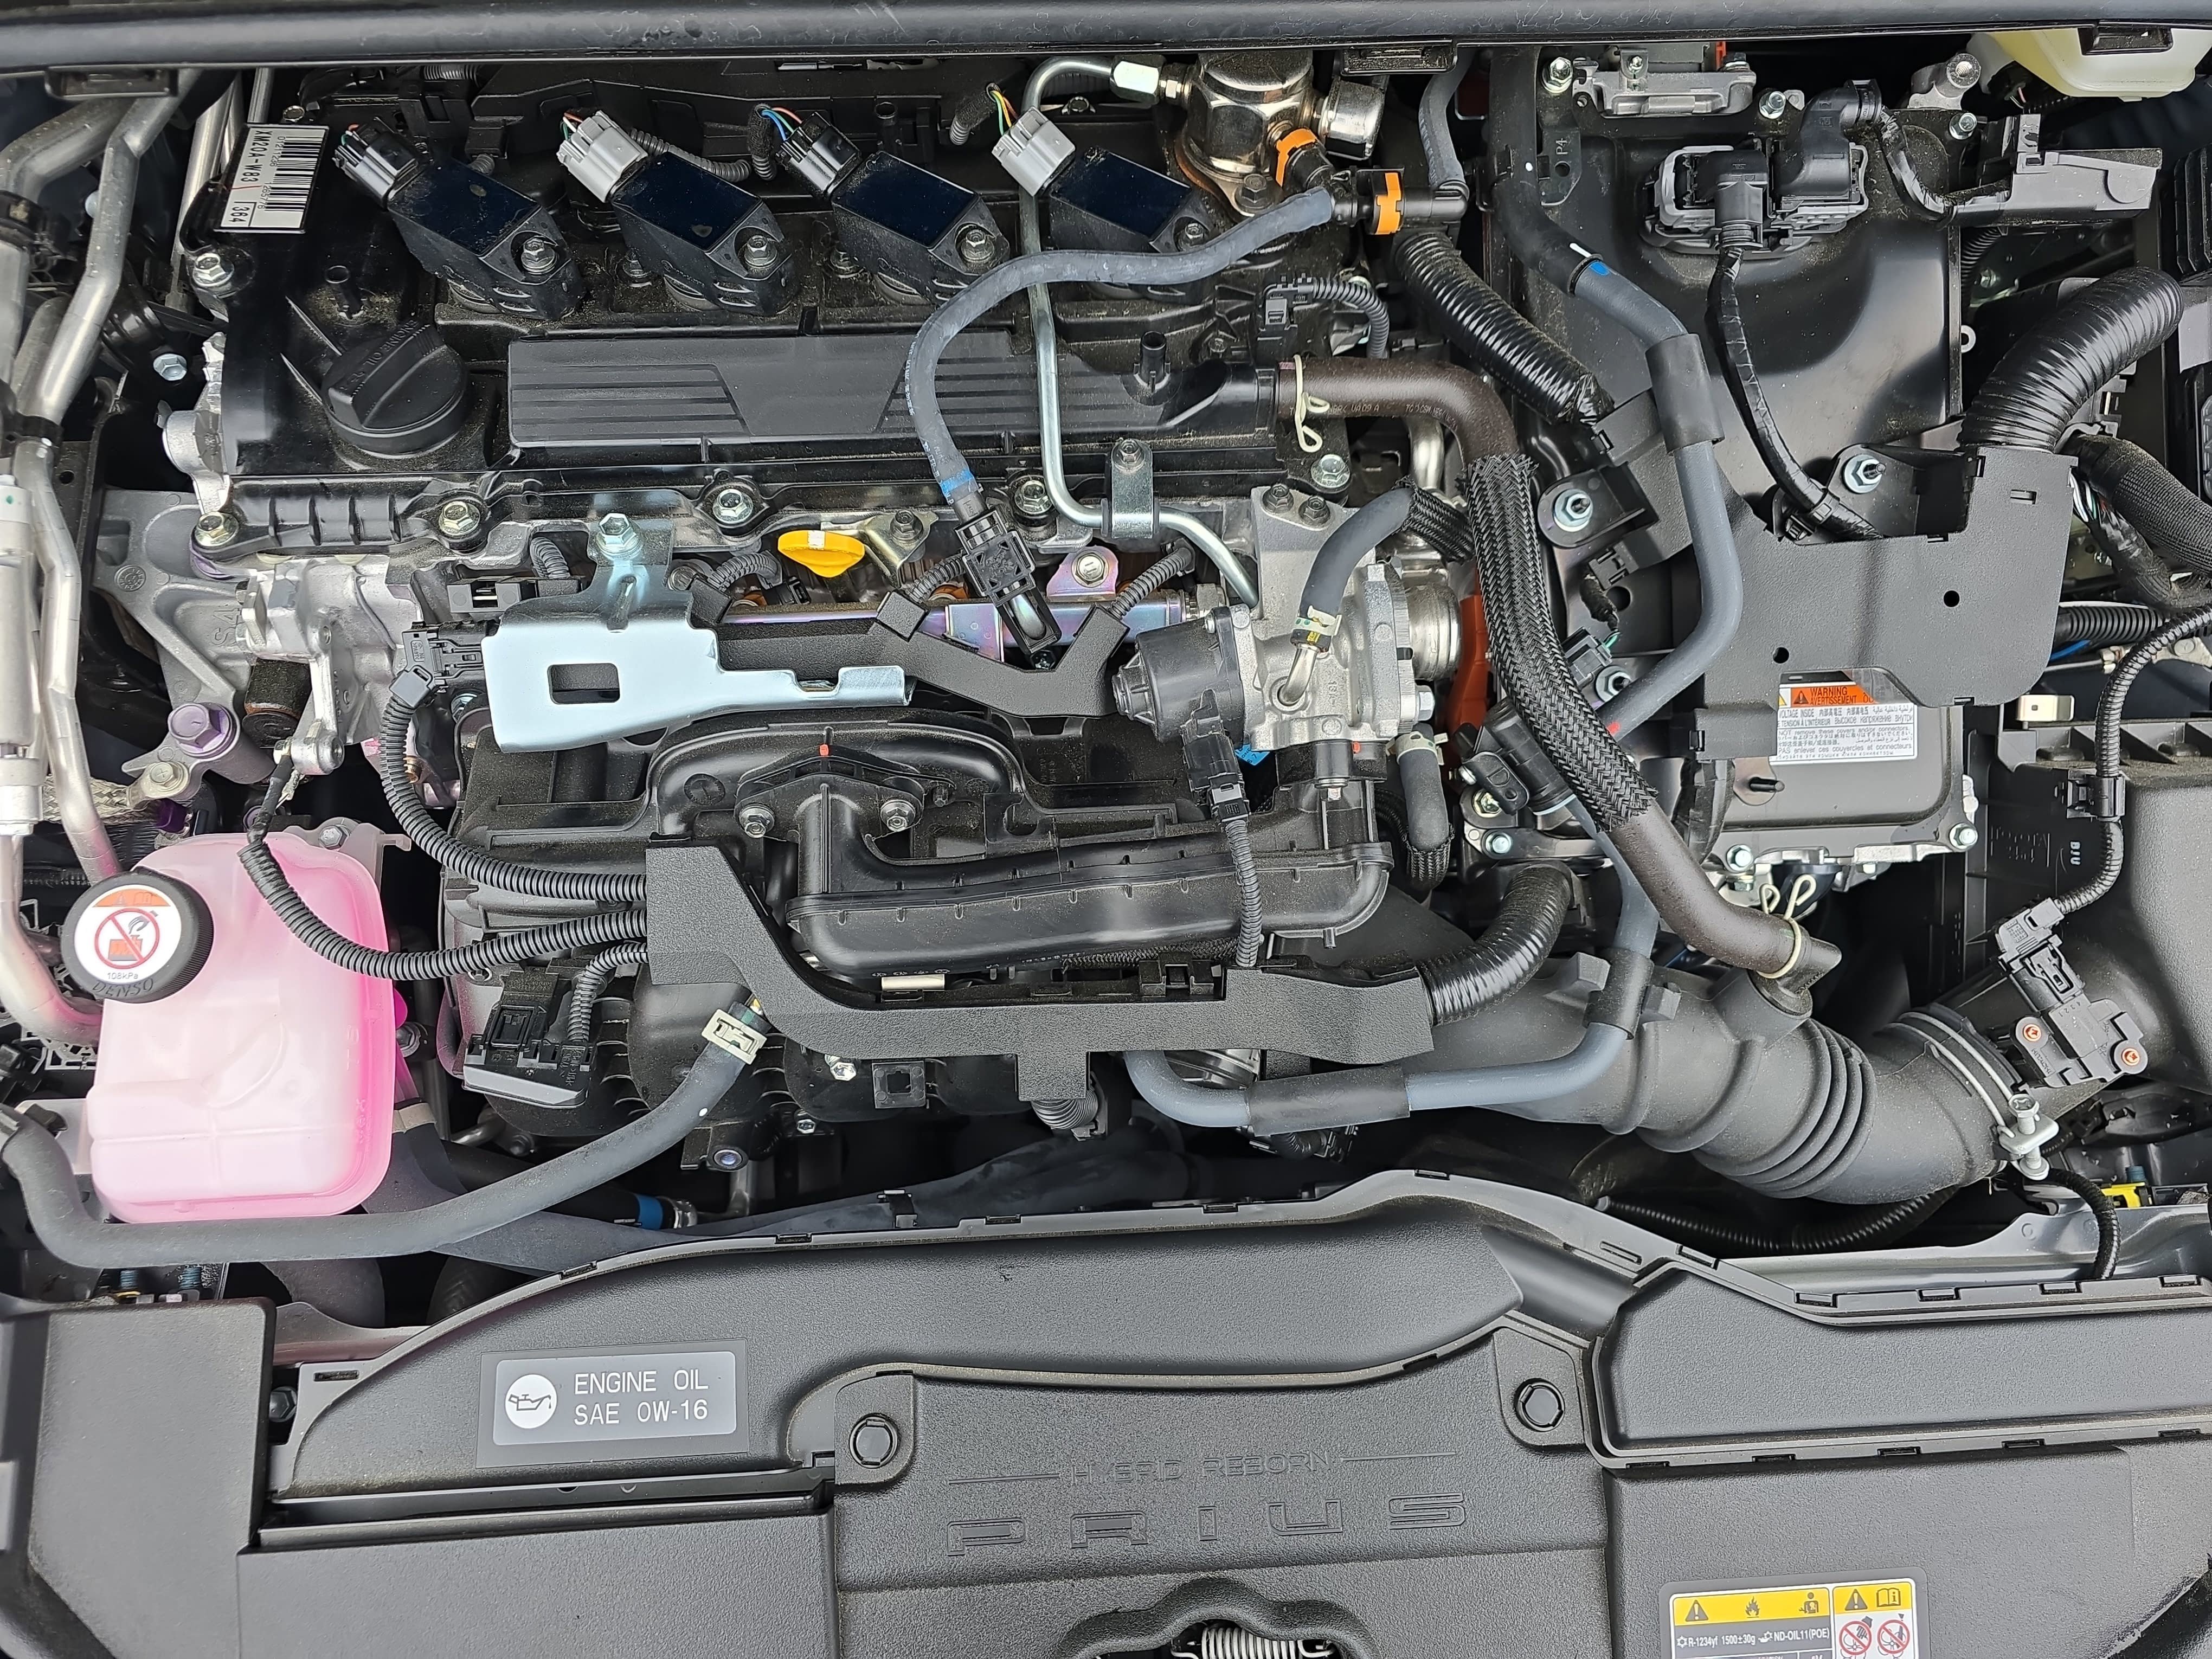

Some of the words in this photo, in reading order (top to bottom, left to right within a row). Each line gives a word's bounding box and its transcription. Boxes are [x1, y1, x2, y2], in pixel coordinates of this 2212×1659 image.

[240, 130, 273, 182] XM20A-W83
[228, 207, 250, 222] 364
[380, 320, 417, 352] ENGINE
[363, 352, 382, 365] OIL
[1810, 686, 1848, 697] WARNING
[1810, 695, 1857, 706] AVERTISSEMENT
[92, 978, 154, 998] DENSO
[574, 1370, 657, 1394] ENGINE
[673, 1368, 709, 1391] OIL
[574, 1402, 620, 1425] SAE
[636, 1399, 708, 1423] 0W-16
[1071, 1459, 1187, 1484] HYBRID
[1203, 1450, 1332, 1477] REBORN
[946, 1491, 1465, 1557] PRIUS
[1688, 1636, 1718, 1648] R-1234yf
[1721, 1634, 1756, 1645] 1500±30g
[1773, 1627, 1830, 1642] ND-OIL11(POE)
